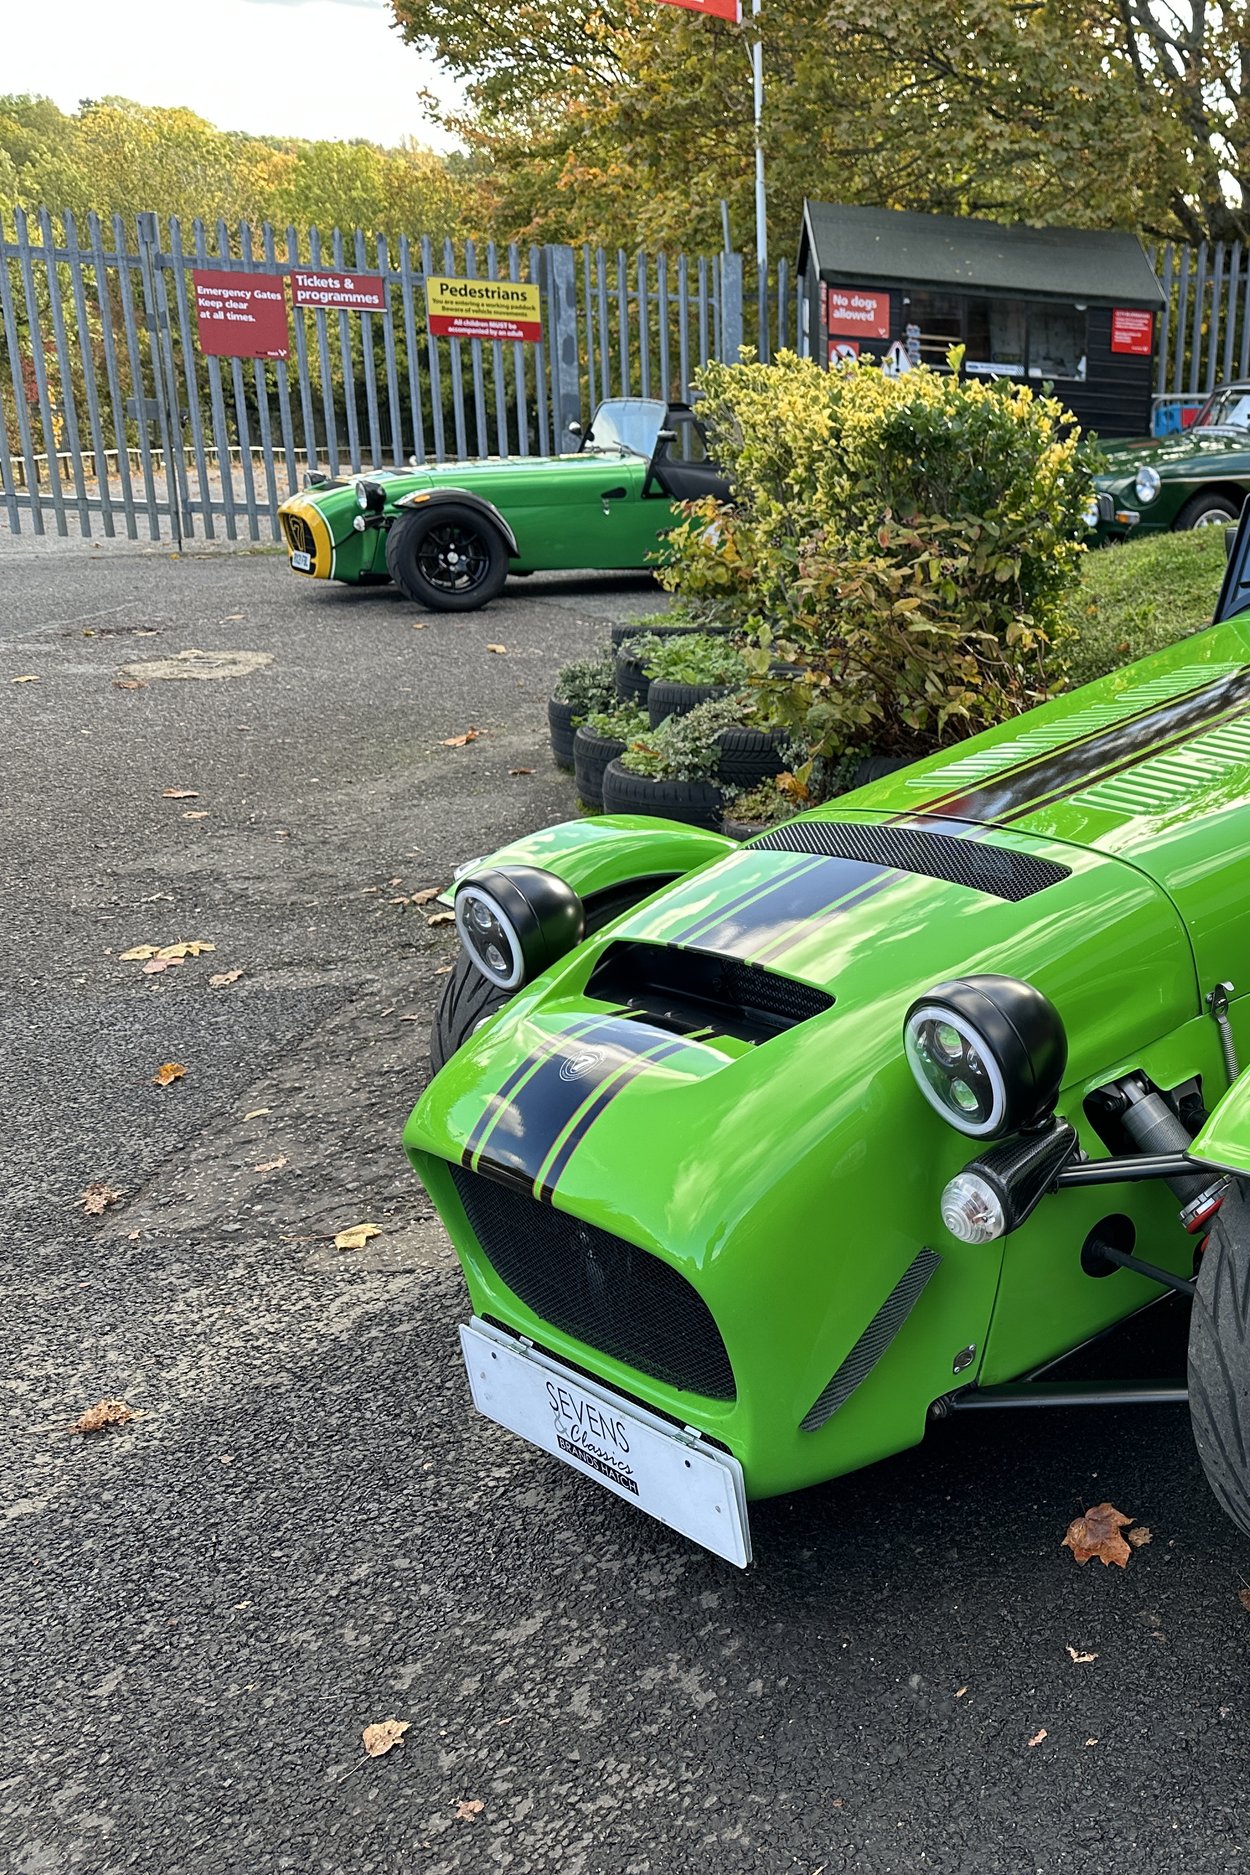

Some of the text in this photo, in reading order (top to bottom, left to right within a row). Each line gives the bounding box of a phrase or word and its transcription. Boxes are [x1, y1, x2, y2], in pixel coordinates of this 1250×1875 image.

[296, 275, 354, 290] Tickets &
[197, 285, 282, 300] Emergency Gates
[297, 290, 379, 304] programmes
[440, 283, 527, 301] Pedestrians
[198, 298, 249, 309] Keep clear
[485, 302, 510, 310] working
[833, 294, 877, 310] No dogs
[200, 311, 256, 322] at all times.
[833, 308, 875, 321] allowed
[463, 319, 488, 328] children
[489, 321, 508, 329] MUST
[508, 322, 517, 330] be
[448, 326, 489, 335] accompanied
[507, 330, 524, 338] adult
[546, 1381, 630, 1453] SEVENS
[554, 1411, 634, 1475] & Classics
[560, 1438, 638, 1494] BRANDS HATCH
